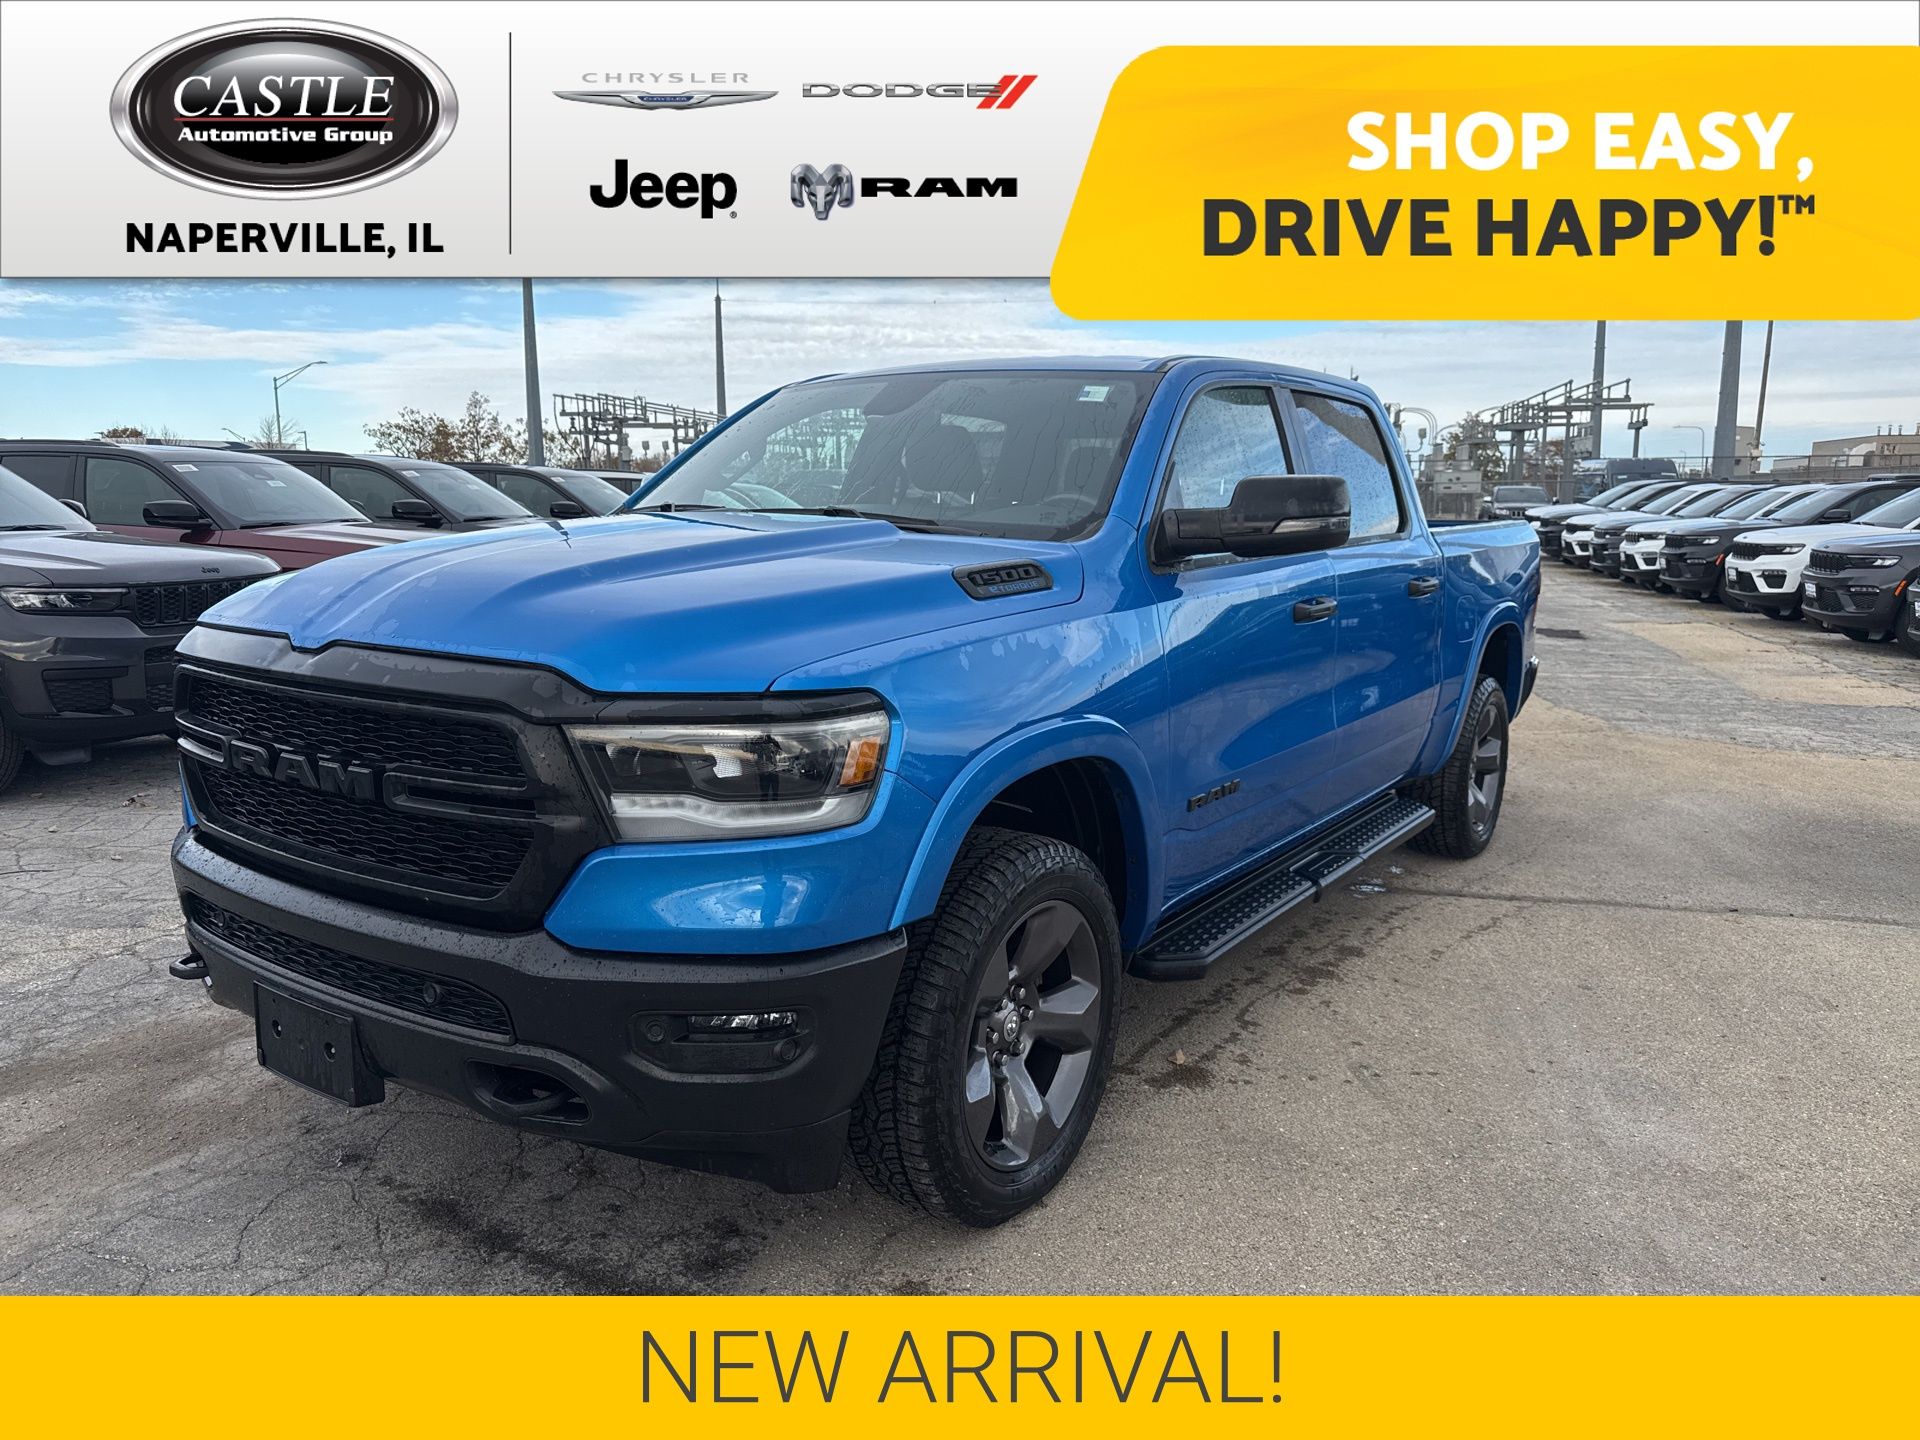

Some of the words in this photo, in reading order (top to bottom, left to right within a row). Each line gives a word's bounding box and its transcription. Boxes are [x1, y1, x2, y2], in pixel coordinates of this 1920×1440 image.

[969, 566, 1037, 586] 1500
[229, 739, 376, 801] RAM
[1187, 778, 1241, 812] RAM
